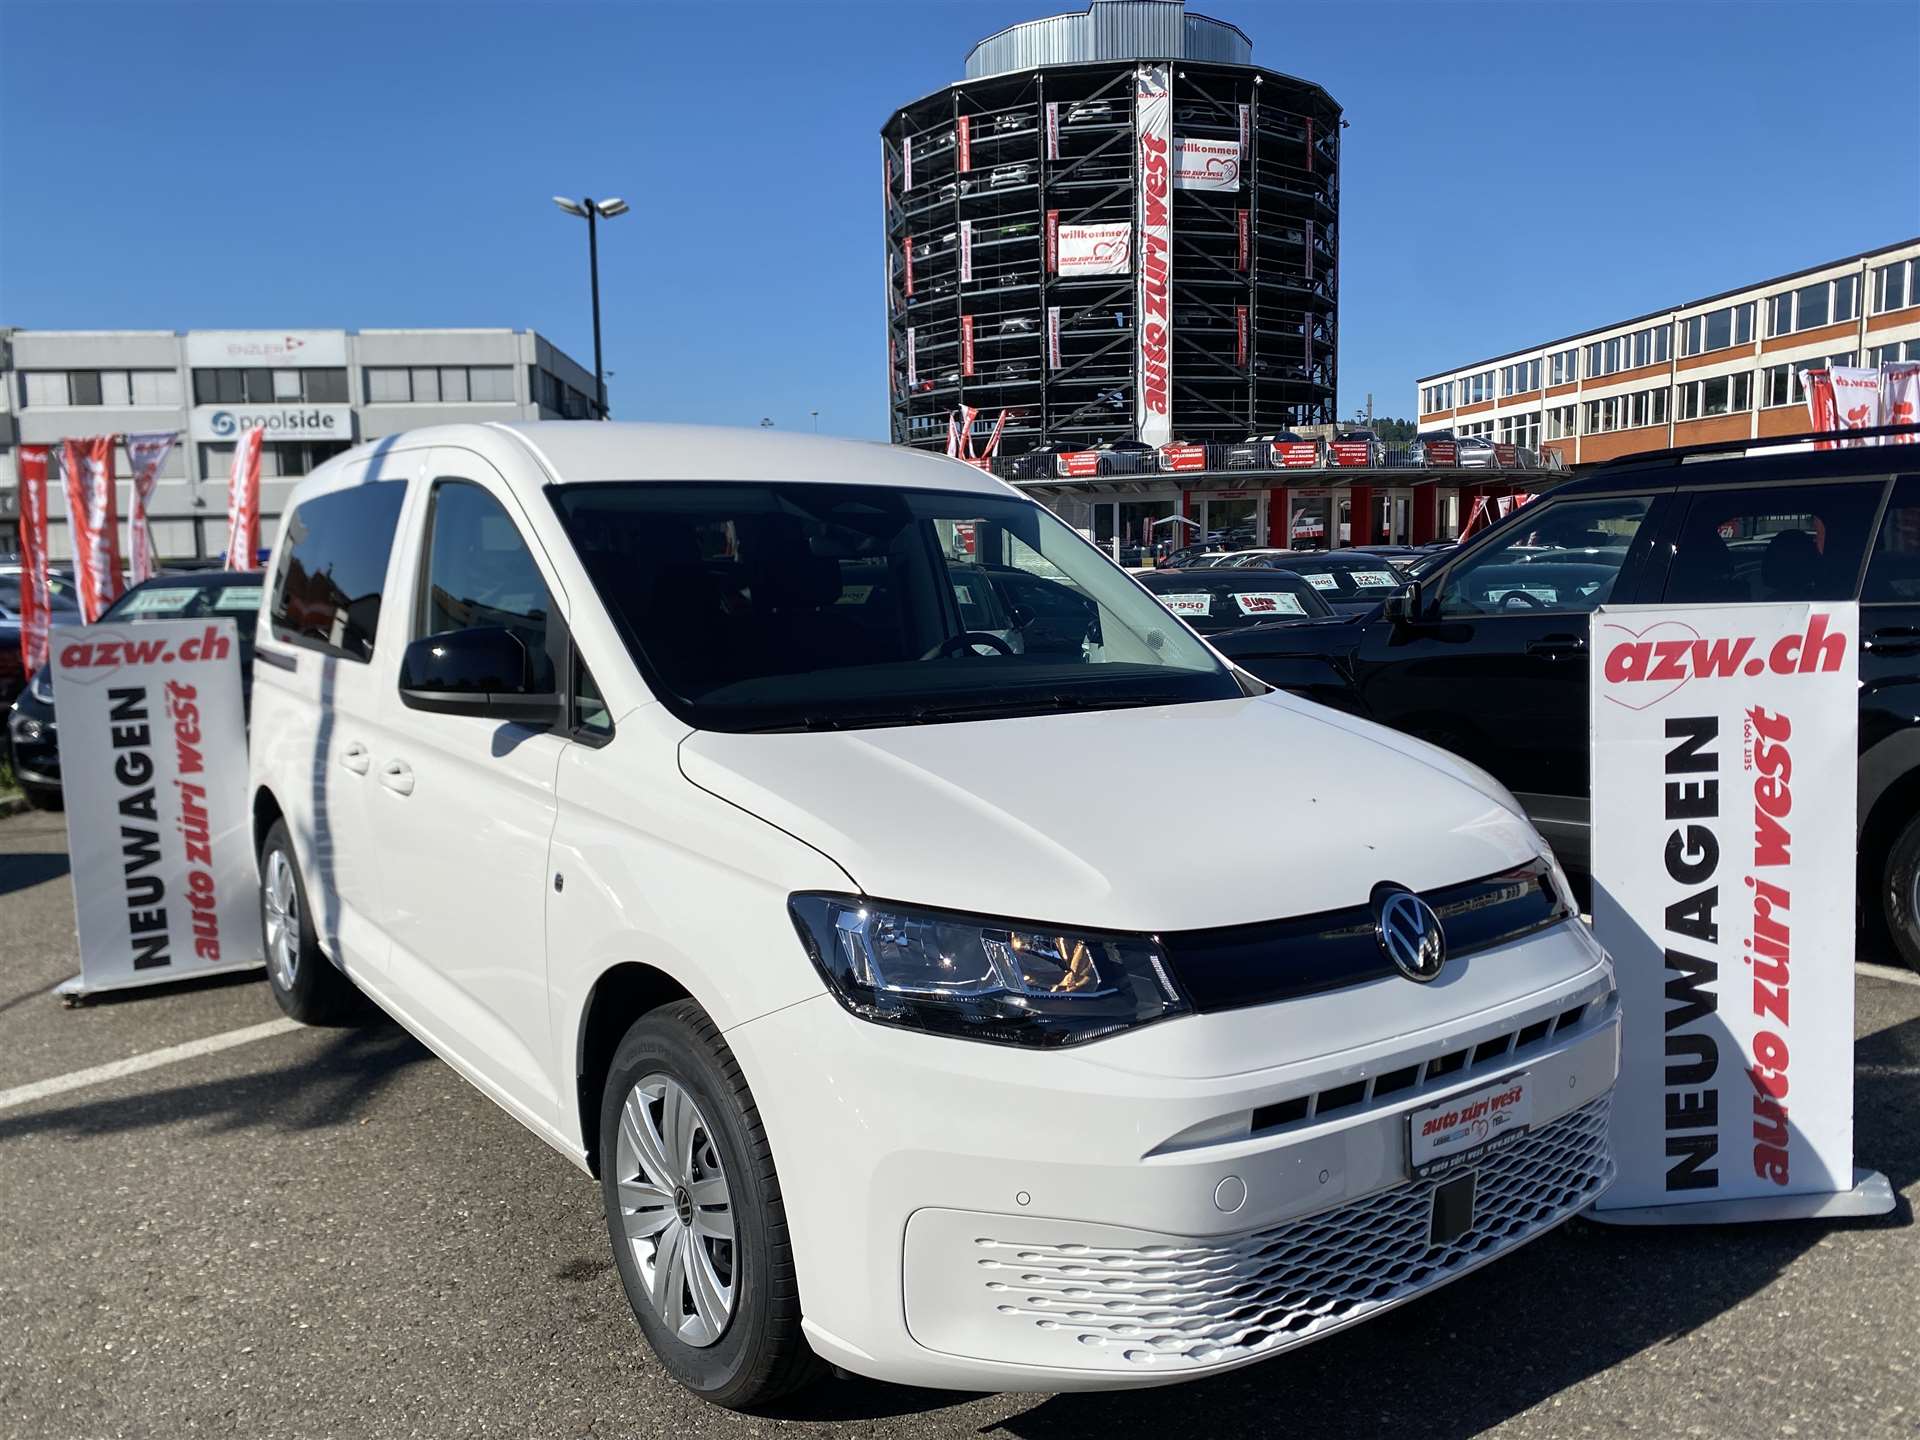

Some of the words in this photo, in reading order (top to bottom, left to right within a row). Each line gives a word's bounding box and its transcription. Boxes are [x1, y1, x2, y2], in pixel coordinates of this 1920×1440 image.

[1141, 133, 1168, 226] west
[1174, 143, 1239, 155] willkommen
[1141, 323, 1168, 416] auto
[240, 410, 335, 430] poolside
[59, 626, 230, 668] azw.ch
[1604, 613, 1847, 684] azw.ch
[164, 679, 205, 775] west
[1744, 749, 1752, 771] SEIT
[108, 685, 171, 971] NEUWAGEN
[173, 779, 213, 867] züri
[1744, 704, 1792, 867] west
[184, 869, 221, 962] auto
[1664, 716, 1720, 1192] NEUWAGEN
[1744, 875, 1791, 1027] züri
[1422, 1112, 1458, 1136] auto
[1460, 1097, 1490, 1124] züri
[1491, 1085, 1523, 1110] west
[1744, 1030, 1790, 1186] auto
